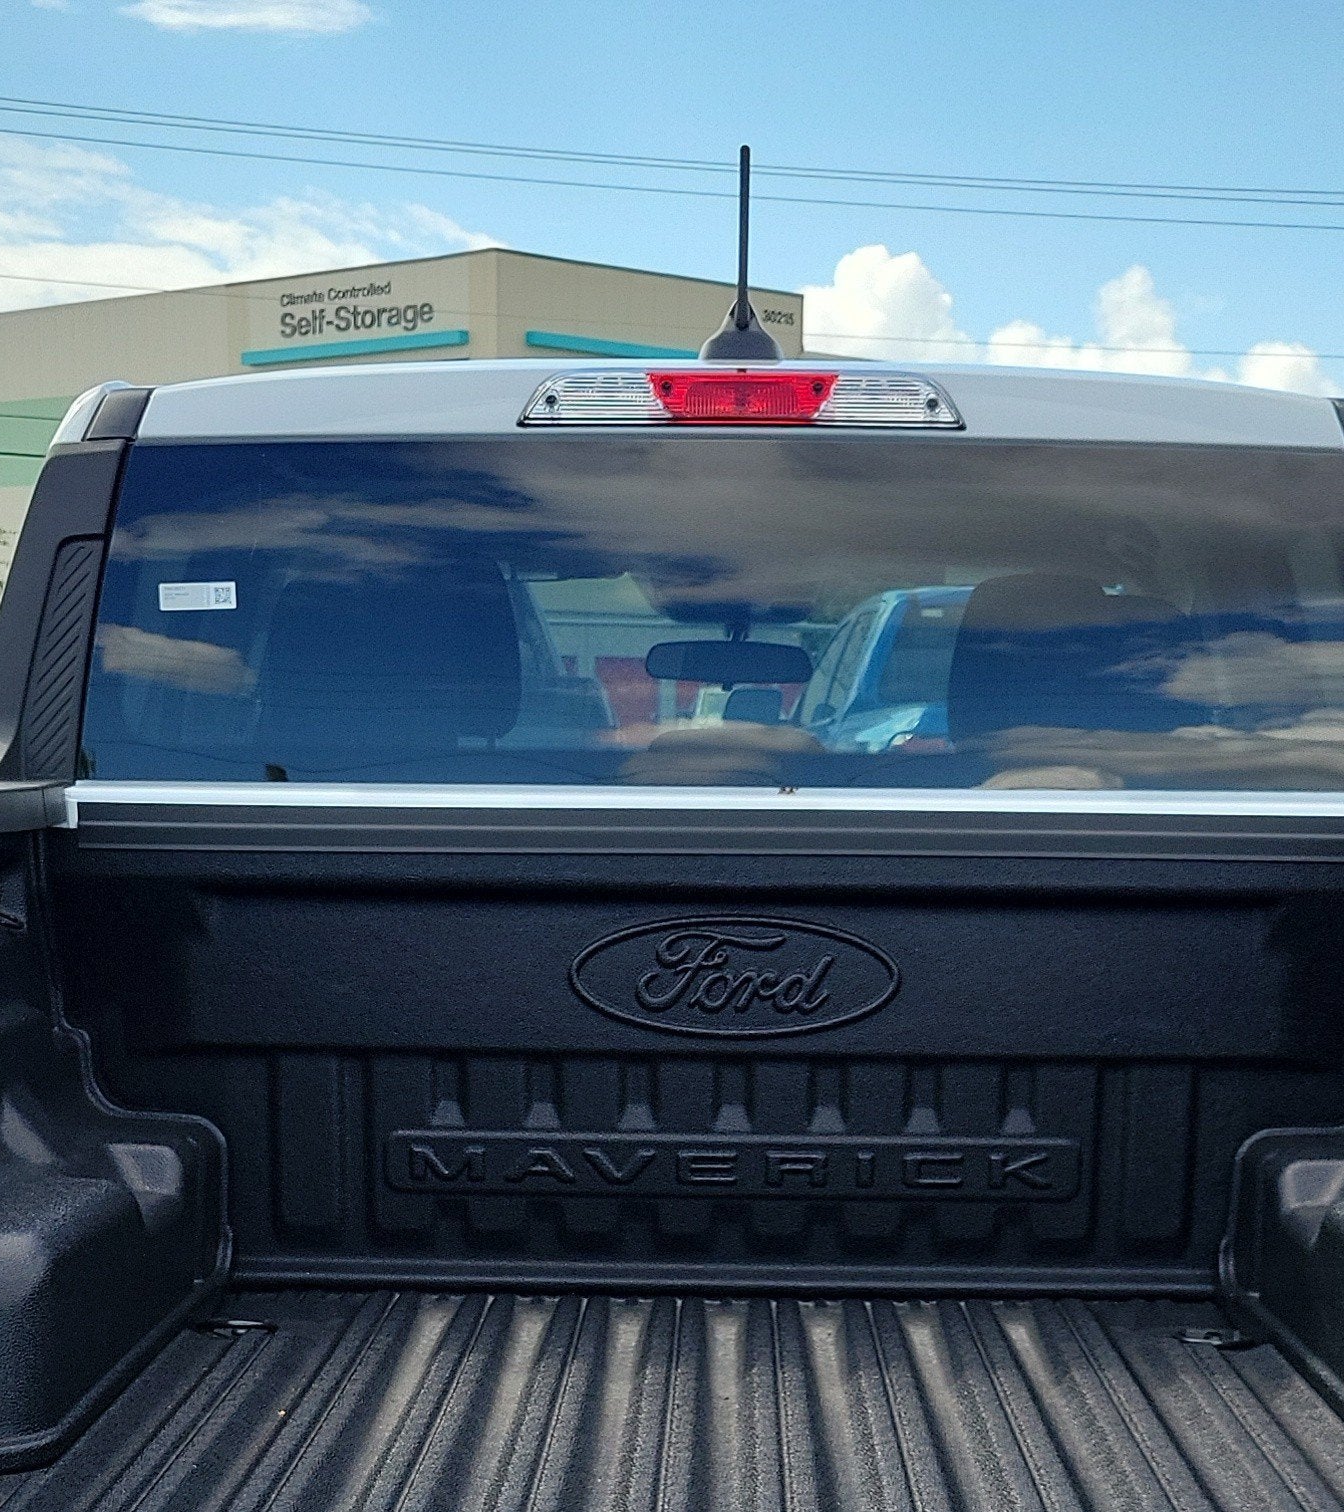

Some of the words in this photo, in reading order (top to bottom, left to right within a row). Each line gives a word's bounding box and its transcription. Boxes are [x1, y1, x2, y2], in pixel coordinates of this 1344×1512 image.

[280, 290, 325, 307] Climate
[327, 281, 391, 301] Controlled
[280, 302, 434, 338] Self-Storage
[635, 929, 835, 1013] Ford
[406, 1144, 1055, 1191] MAVERICK
